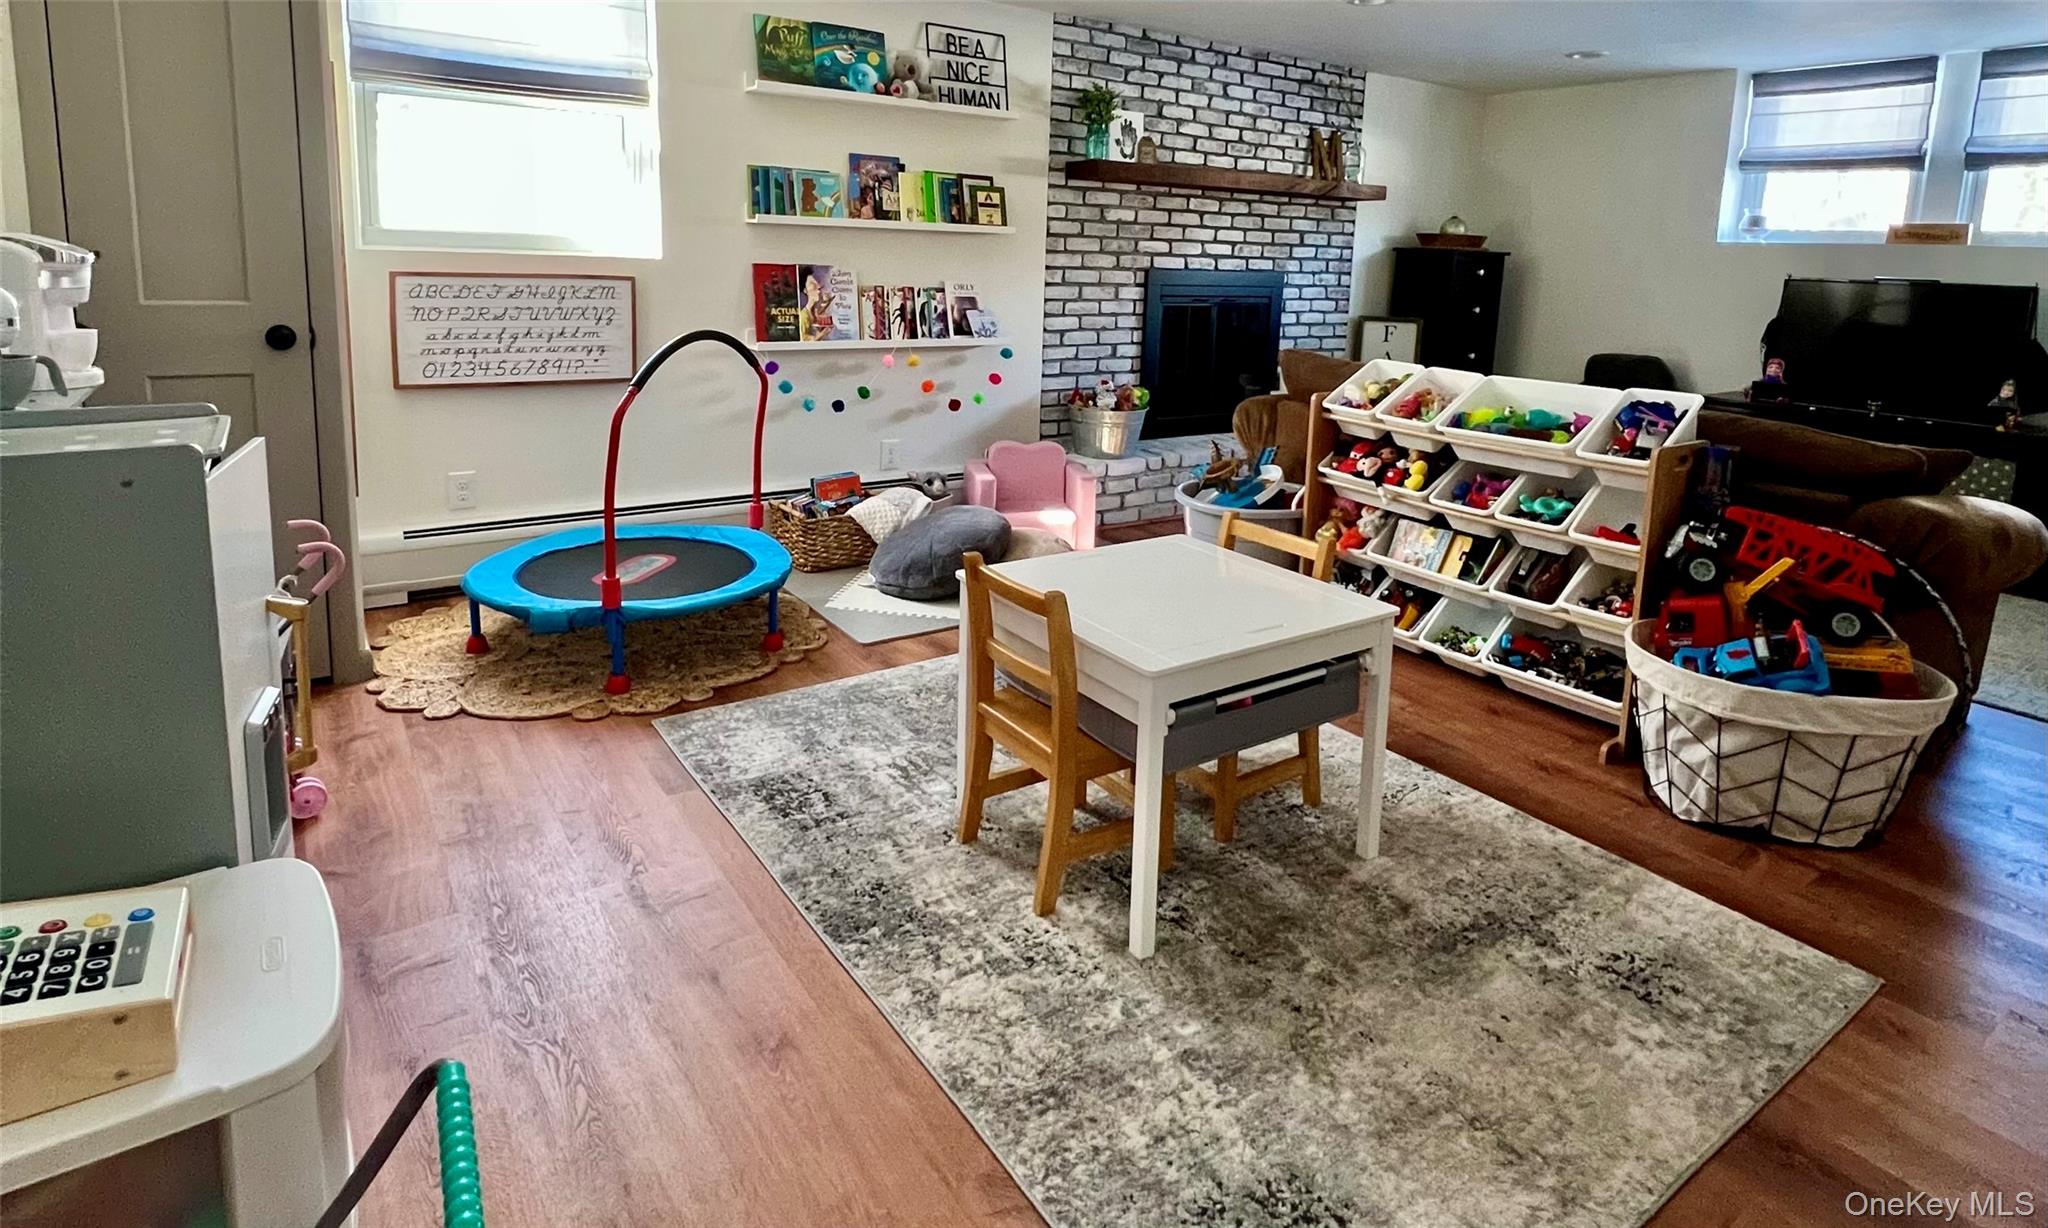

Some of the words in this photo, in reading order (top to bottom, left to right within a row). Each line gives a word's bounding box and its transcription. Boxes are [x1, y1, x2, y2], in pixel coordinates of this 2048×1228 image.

[946, 33, 970, 57] BE
[974, 39, 987, 59] A
[947, 60, 990, 85] NICE
[938, 85, 1001, 110] HUMAN
[953, 283, 974, 291] ORLY
